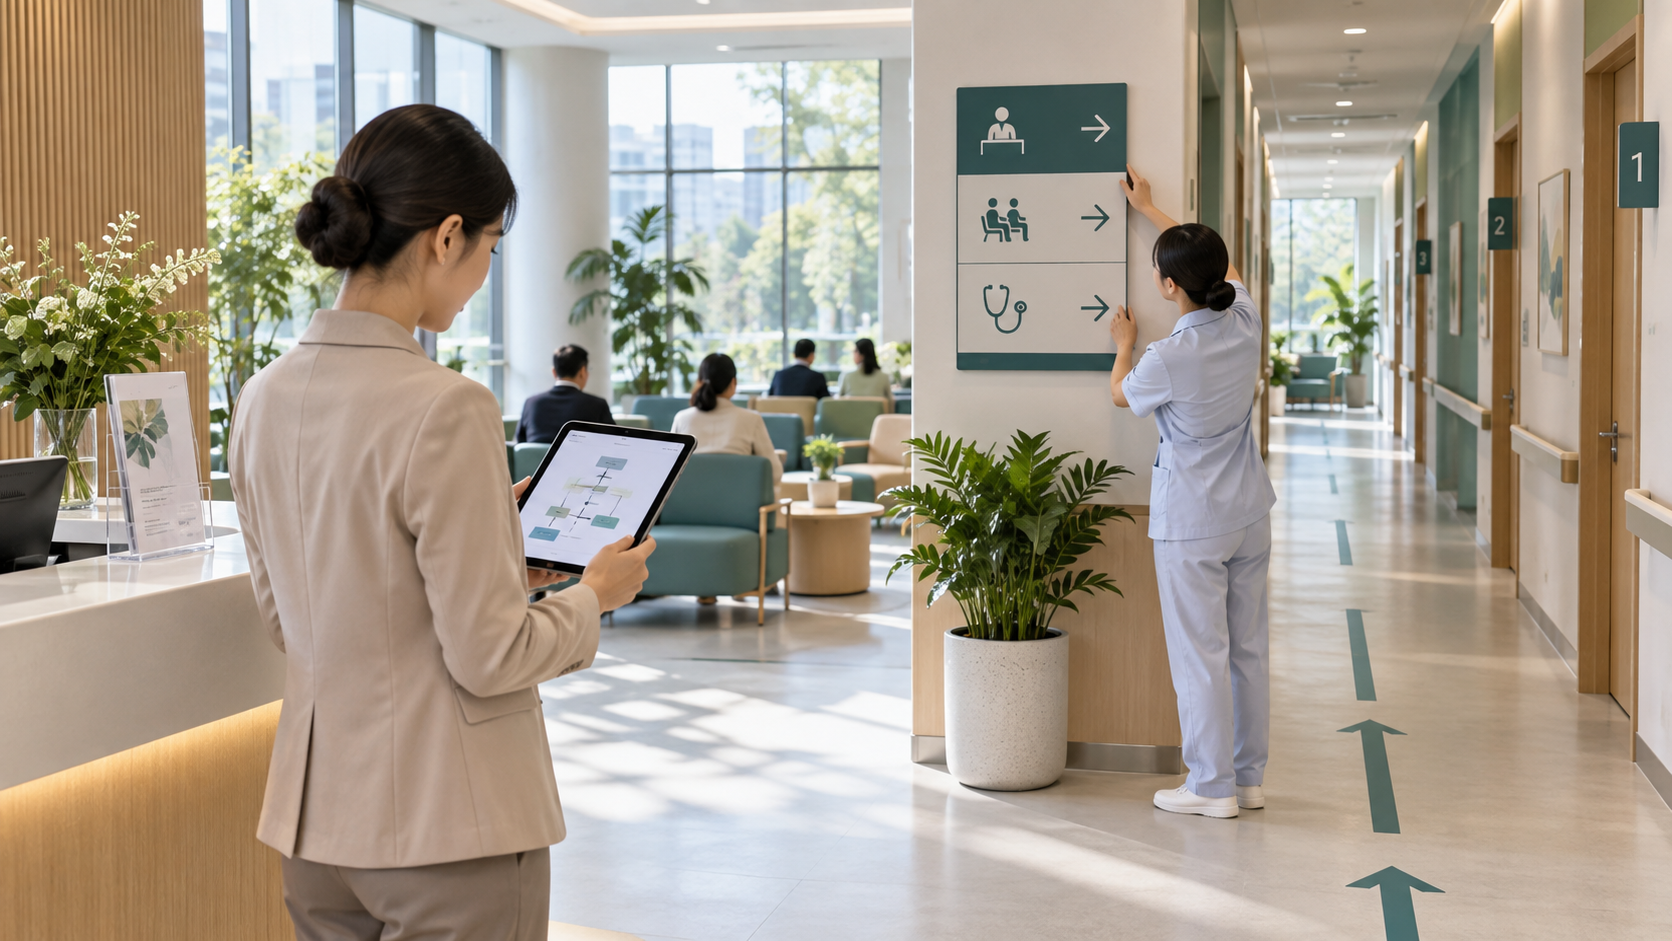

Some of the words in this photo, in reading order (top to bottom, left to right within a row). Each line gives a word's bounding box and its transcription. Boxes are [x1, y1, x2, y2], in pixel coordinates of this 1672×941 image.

[1631, 152, 1643, 182] 1
[1494, 216, 1505, 235] 2
[1419, 251, 1427, 266] 3
